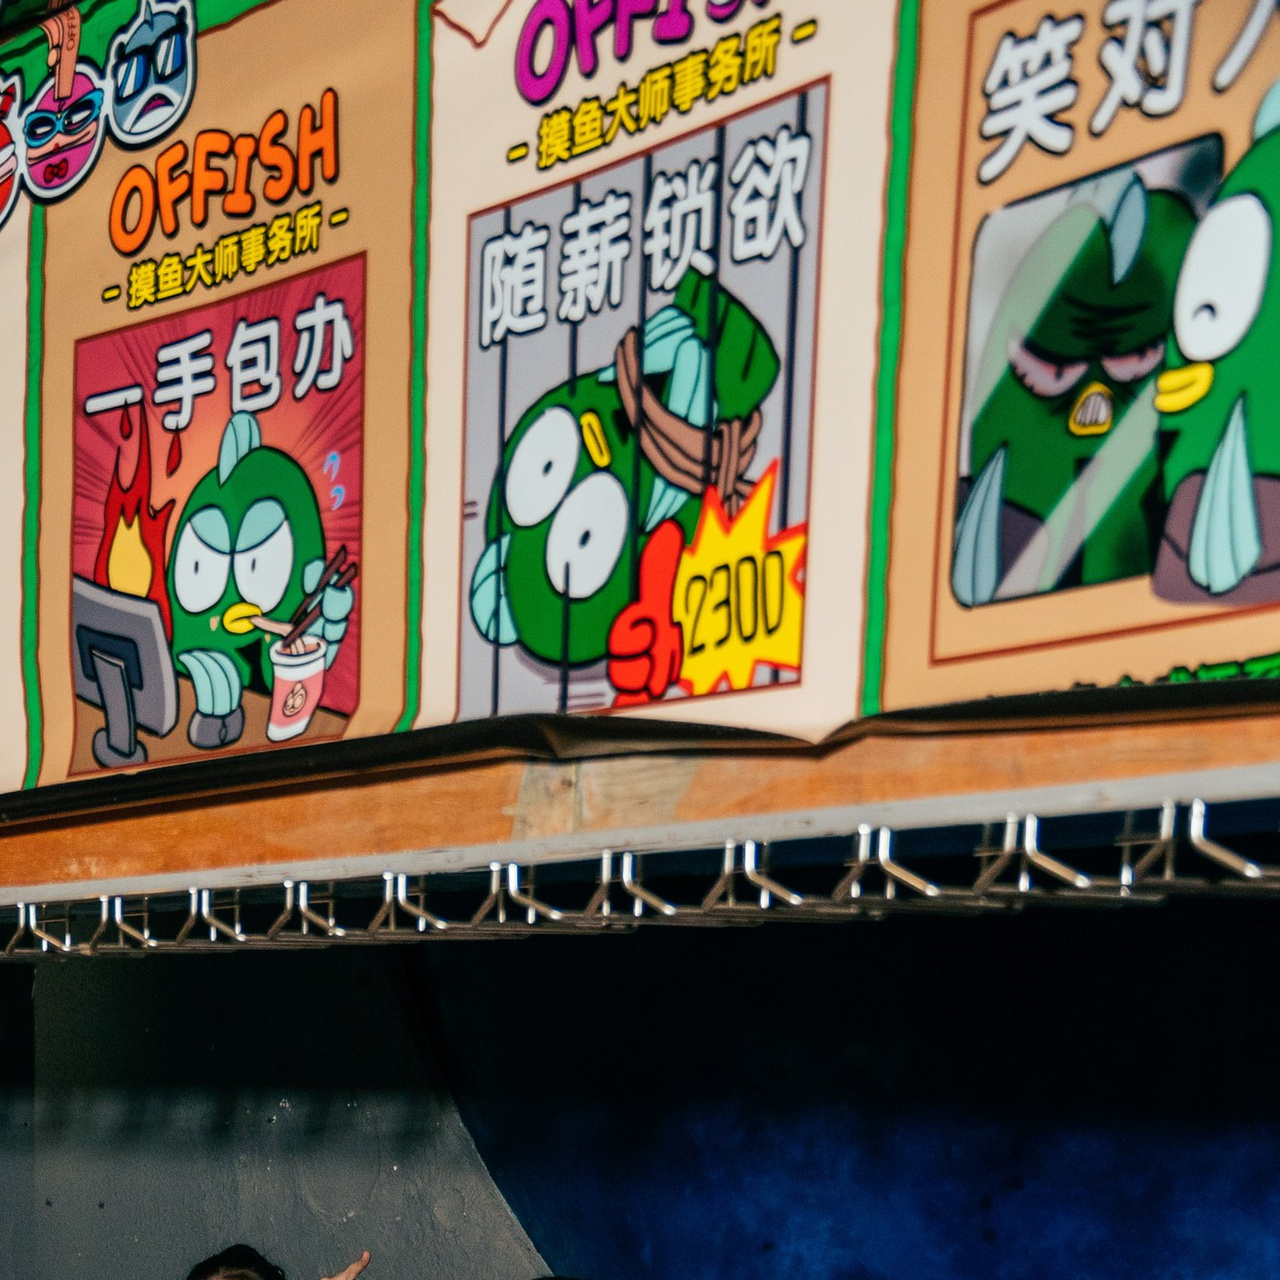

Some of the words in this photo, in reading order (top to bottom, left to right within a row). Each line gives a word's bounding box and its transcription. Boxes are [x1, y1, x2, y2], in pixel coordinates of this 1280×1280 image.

[537, 14, 782, 170] 摸鱼大师事务所
[108, 87, 340, 256] OFFISH
[479, 127, 812, 349] 随薪锁欲
[128, 214, 323, 308] 摸鱼大师事务所
[84, 294, 356, 433] 一手包办
[685, 550, 787, 656] 2300
